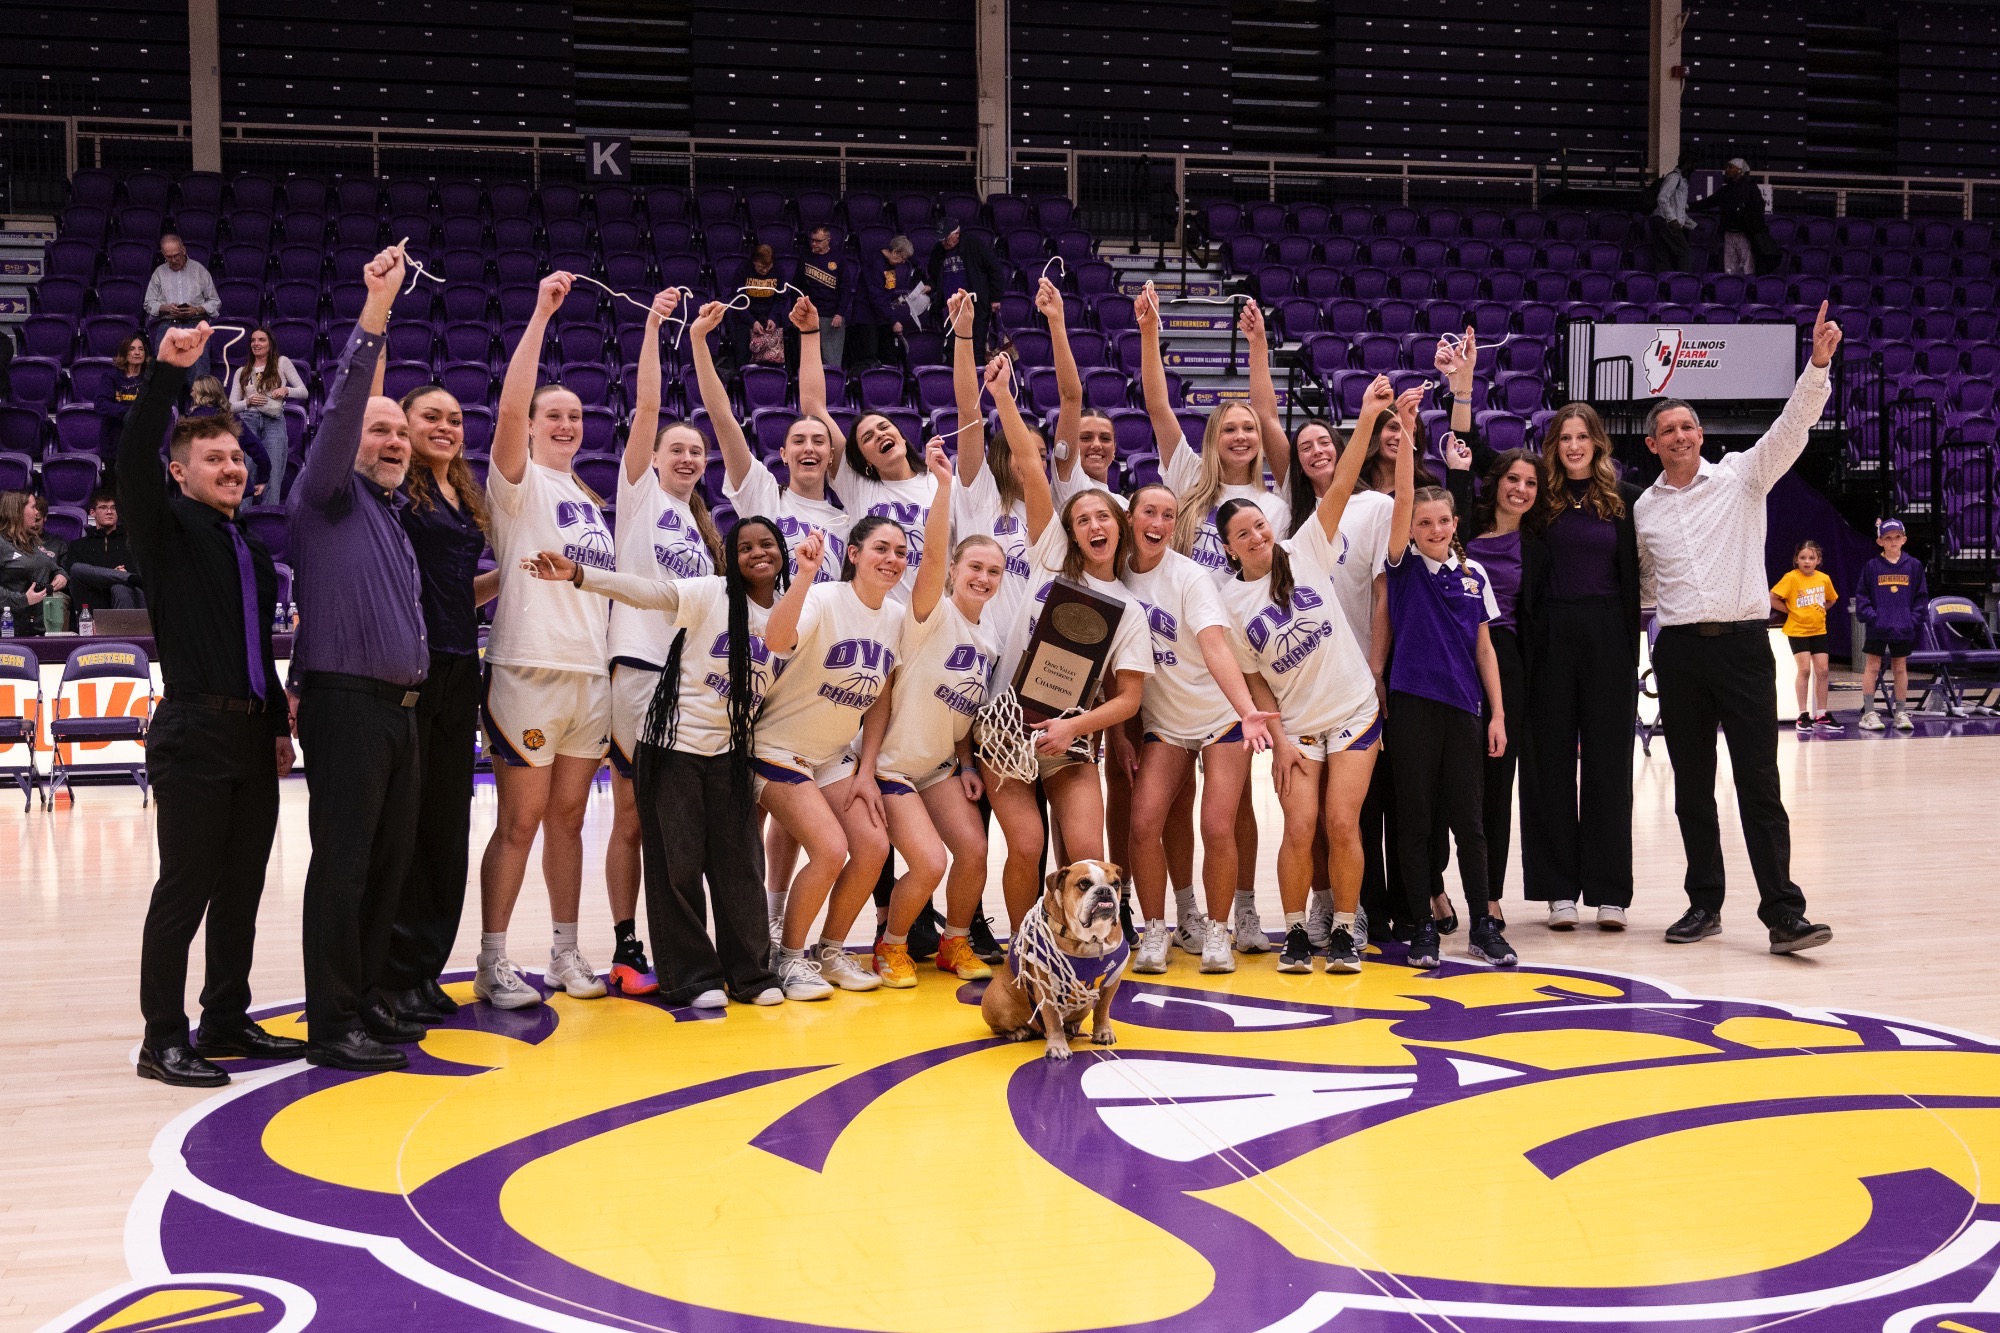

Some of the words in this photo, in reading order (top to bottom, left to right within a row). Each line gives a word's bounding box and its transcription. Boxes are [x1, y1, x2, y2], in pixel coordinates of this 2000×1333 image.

[593, 142, 622, 174] K
[1170, 320, 1210, 328] LEATHERNECKS
[1682, 341, 1726, 349] ILLINOIS
[1679, 350, 1708, 358] FARM
[1676, 359, 1719, 368] BUREAU
[1245, 586, 1324, 653] OVC
[1270, 620, 1334, 675] CHAMPS
[77, 652, 136, 667] WESTERN
